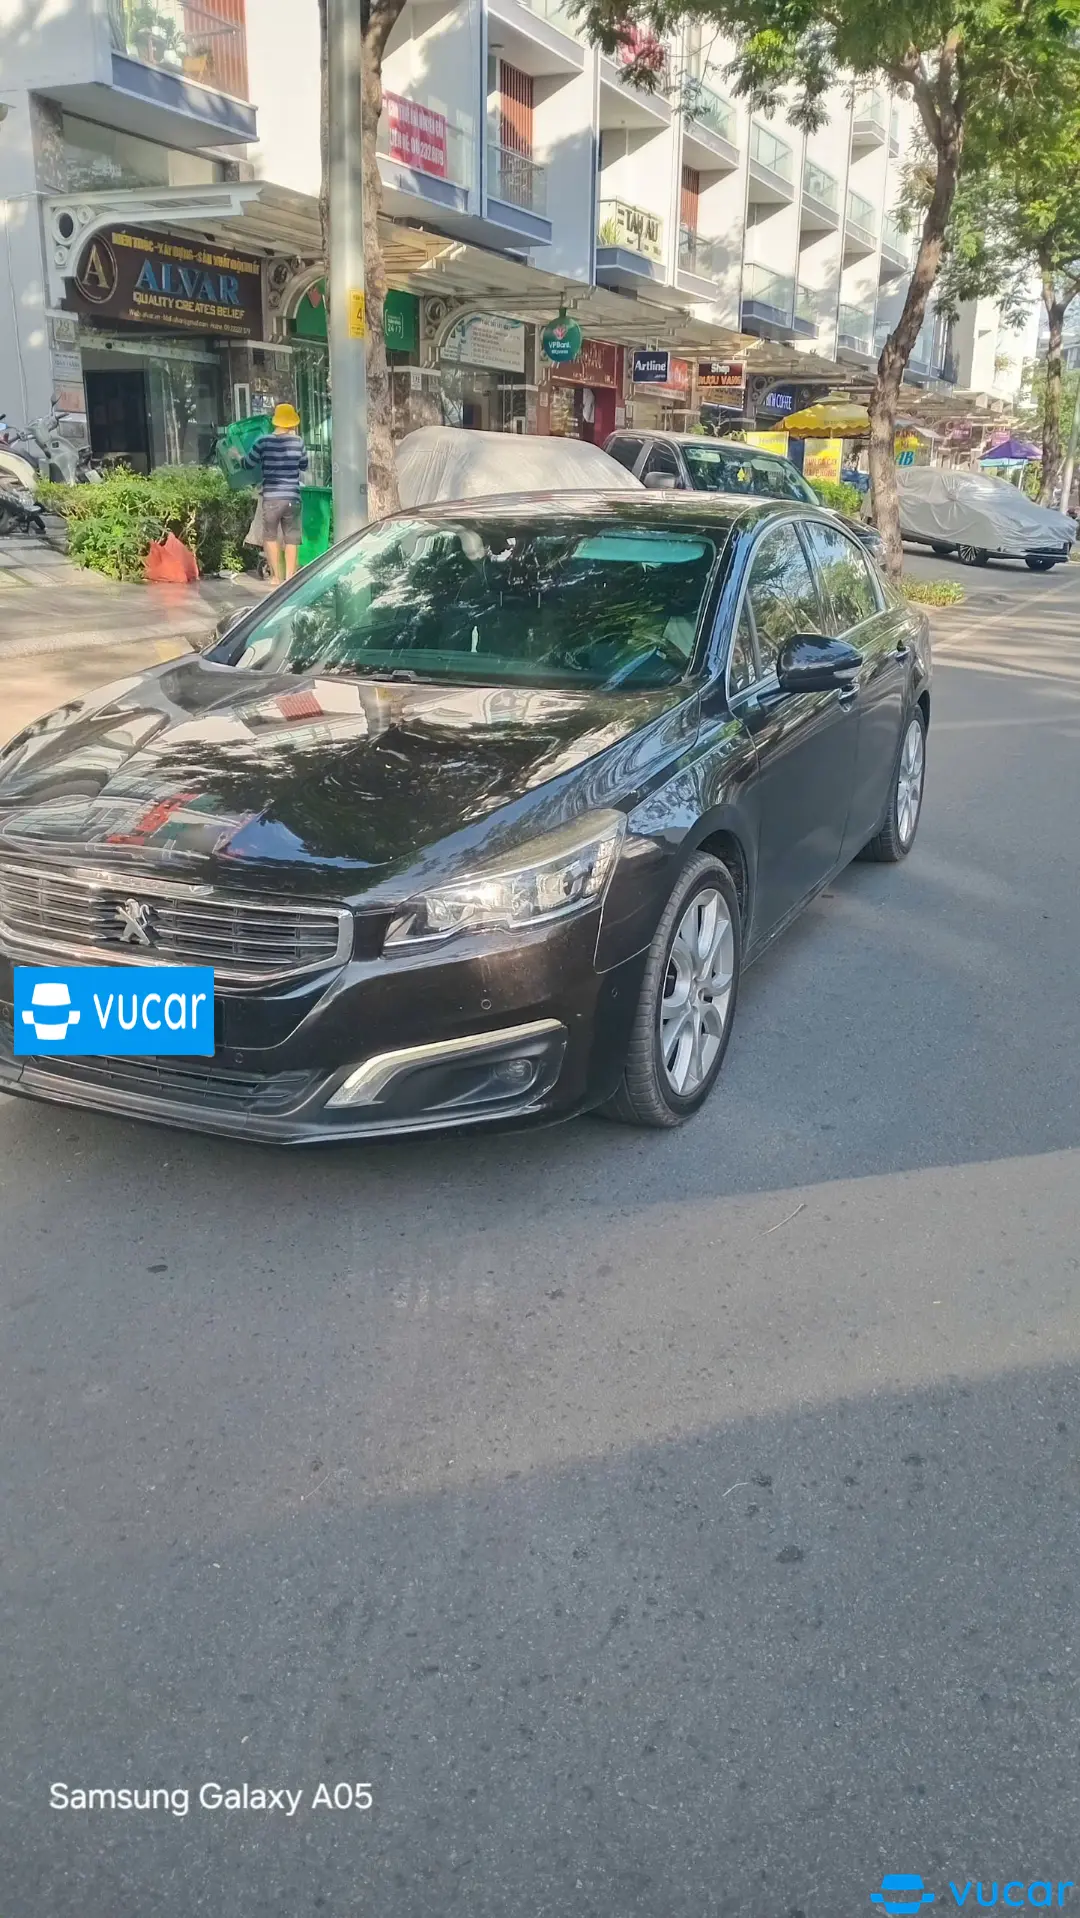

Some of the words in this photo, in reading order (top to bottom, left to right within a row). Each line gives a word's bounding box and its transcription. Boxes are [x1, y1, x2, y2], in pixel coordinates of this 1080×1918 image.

[82, 243, 110, 289] A
[134, 258, 241, 305] ALVAR
[133, 291, 175, 309] QUALITY
[175, 299, 216, 316] CREATES
[216, 305, 246, 320] BELIEF
[634, 360, 667, 372] Artline
[711, 363, 730, 375] Shop
